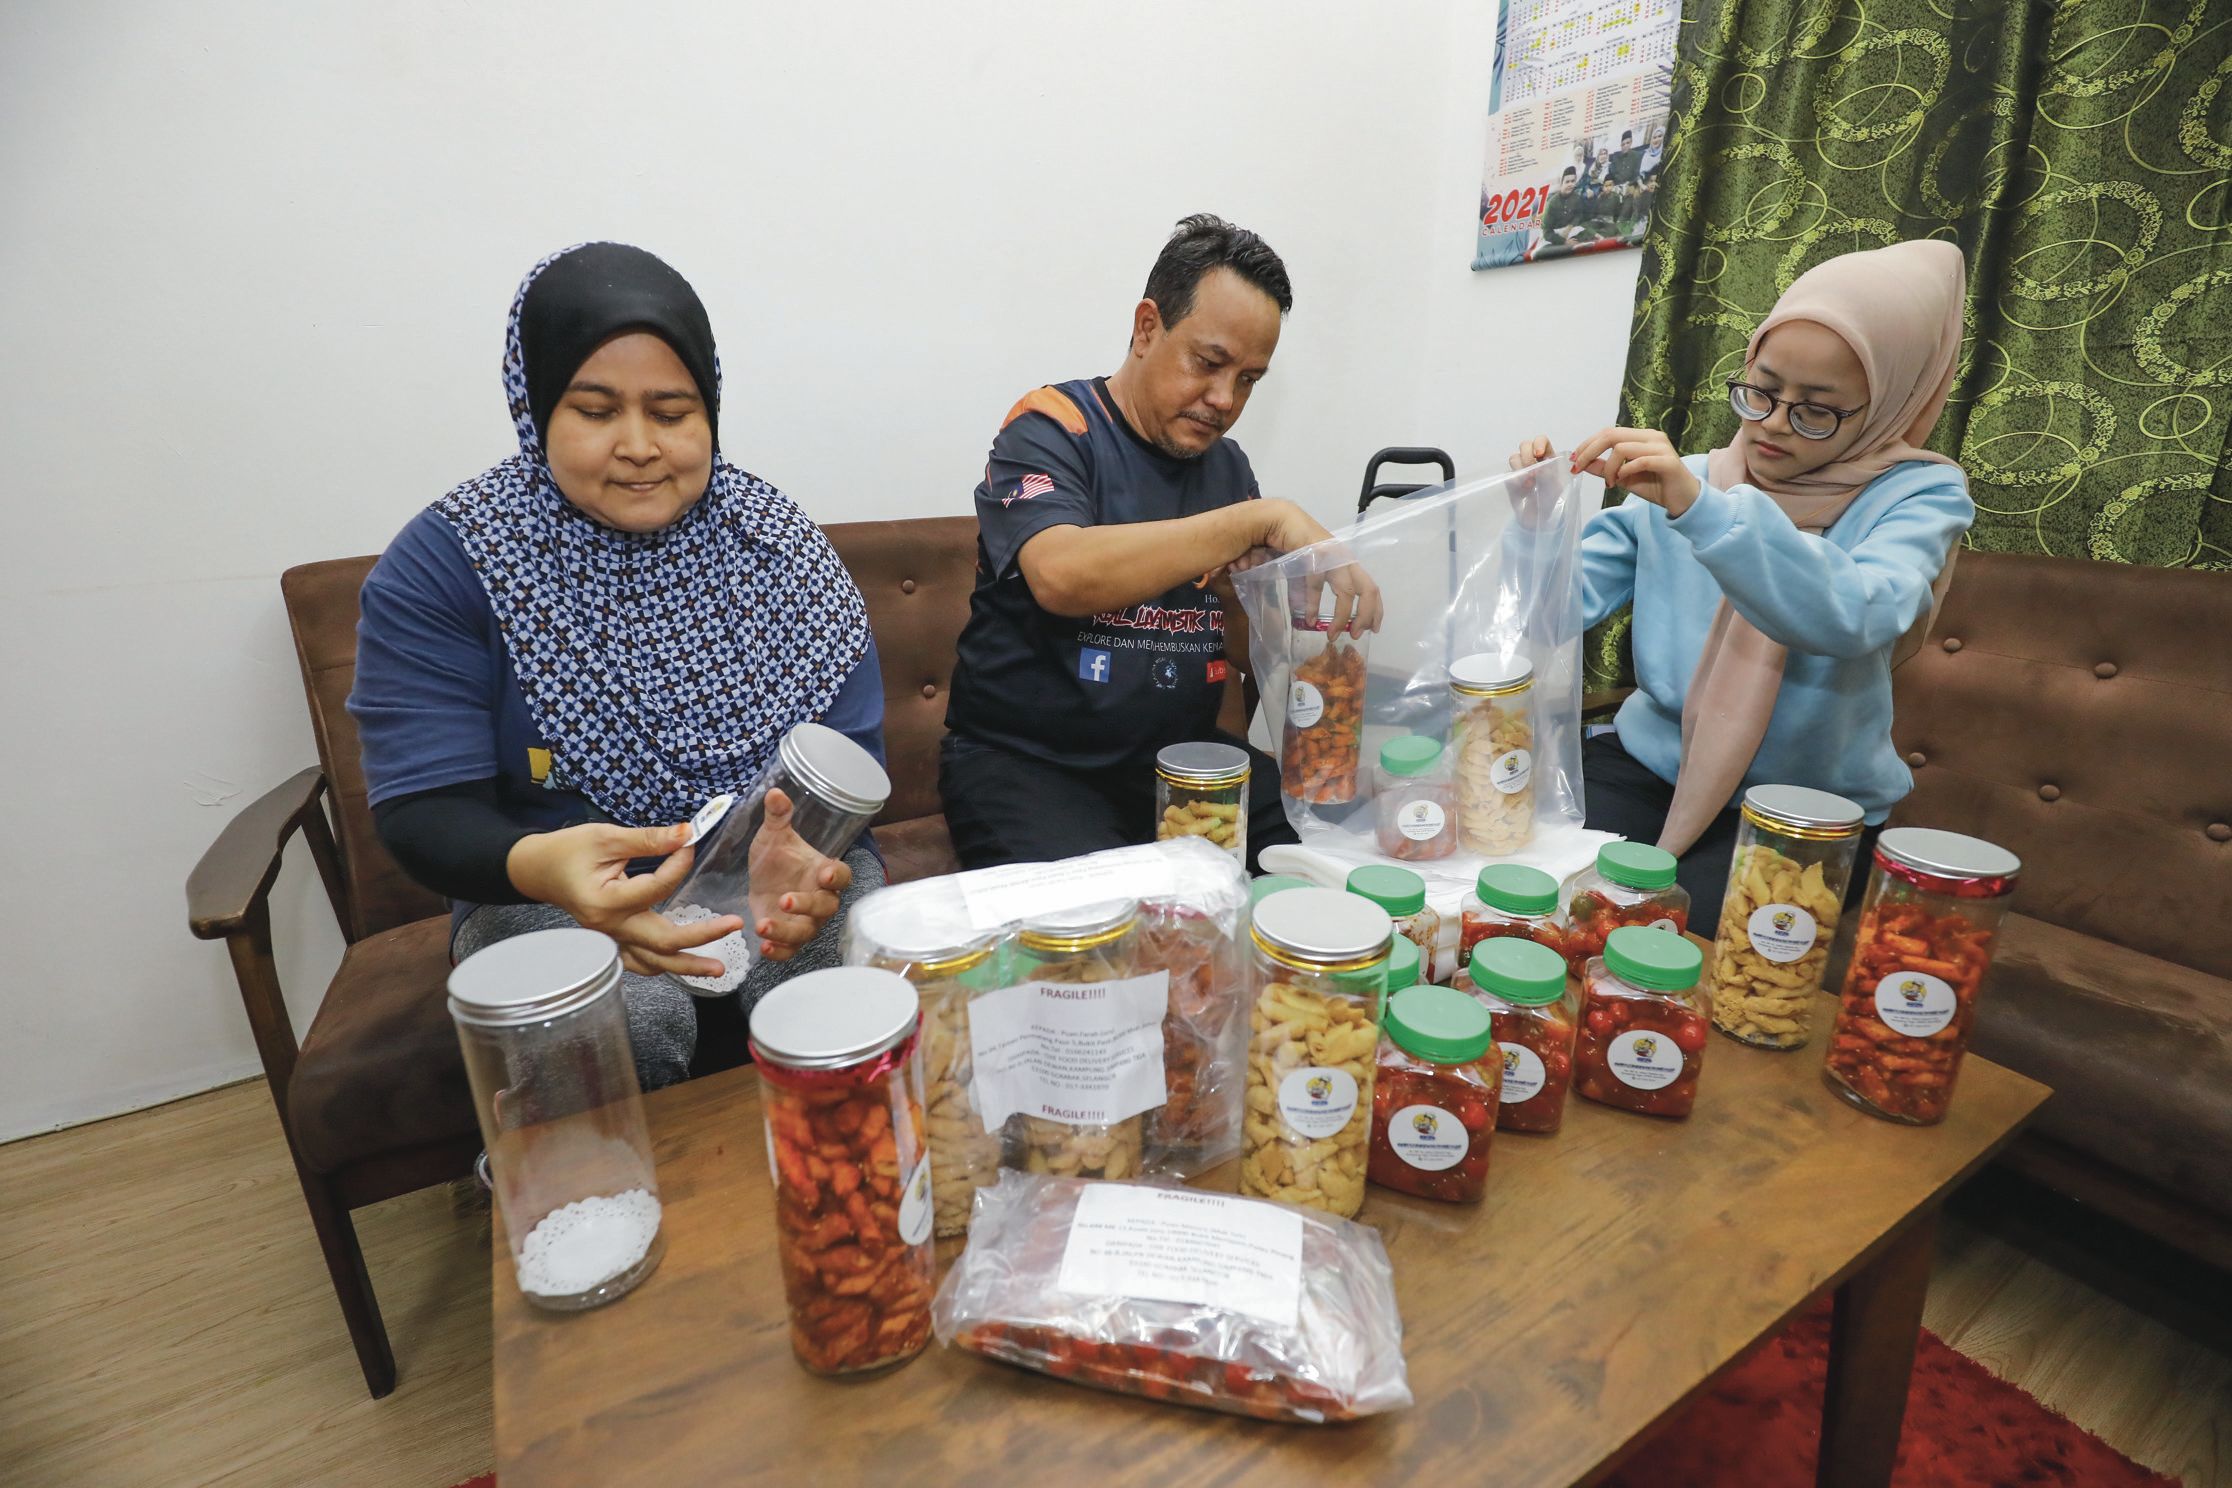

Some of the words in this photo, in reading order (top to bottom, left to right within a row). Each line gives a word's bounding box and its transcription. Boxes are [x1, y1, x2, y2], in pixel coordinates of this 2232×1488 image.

[1483, 184, 1551, 225] 2021
[1482, 219, 1543, 237] CALENDAR
[1078, 631, 1112, 647] EXPLORE
[1113, 637, 1135, 649] DAN
[1040, 987, 1106, 1001] FRAGILE!!!!
[1042, 1104, 1105, 1120] FRAGILE!!!!
